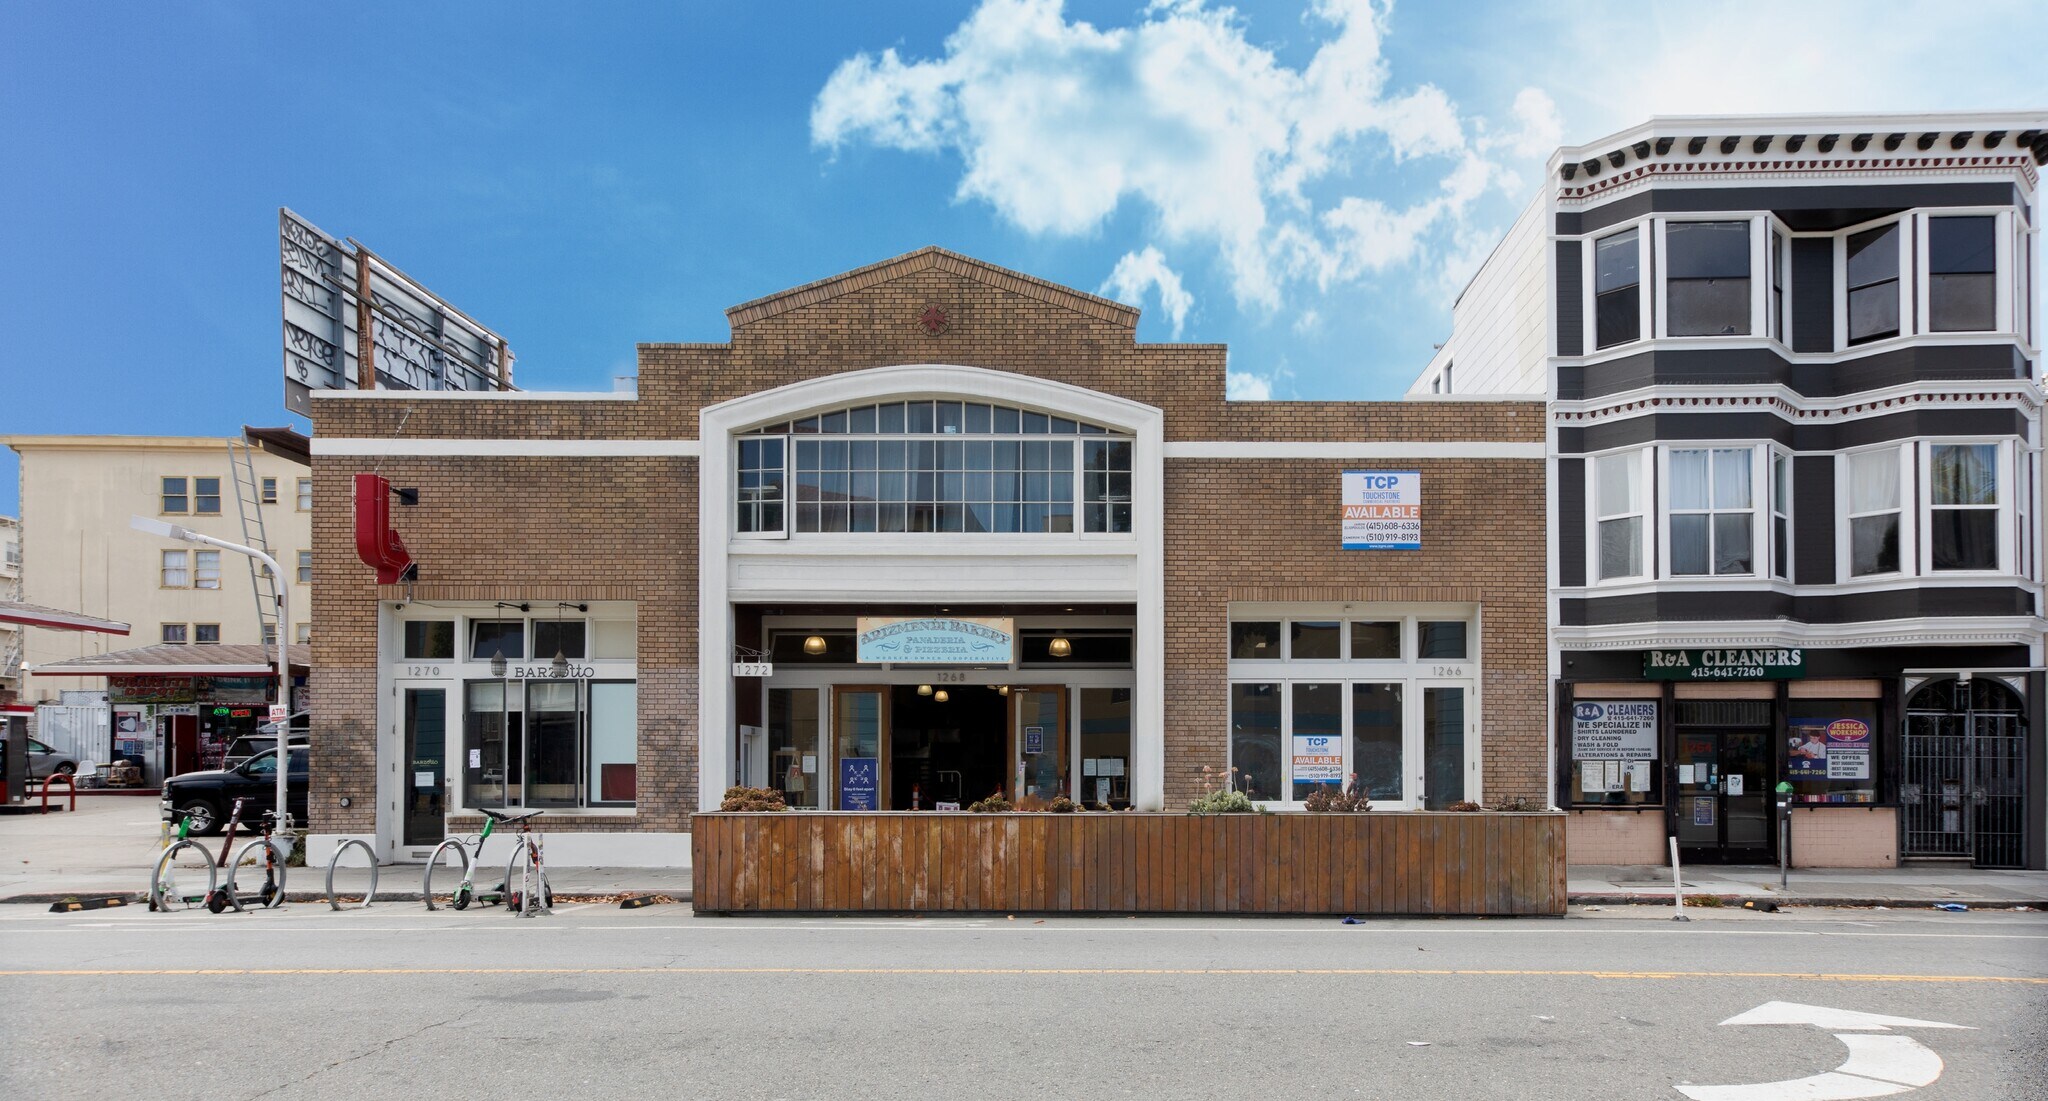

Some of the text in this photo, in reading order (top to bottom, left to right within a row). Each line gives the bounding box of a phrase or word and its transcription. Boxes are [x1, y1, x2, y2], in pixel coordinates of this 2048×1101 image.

[1363, 476, 1399, 489] TCP
[1362, 491, 1400, 500] TOUCHSTONE
[1344, 506, 1419, 519] AVAILABLE
[861, 621, 1010, 645] ARIZMENDI BAKERY
[906, 636, 966, 644] PANADERIA
[903, 645, 969, 654] & PIZZERIA
[1650, 650, 1691, 667] R&A
[1701, 650, 1802, 666] CLEANERS
[407, 666, 440, 676] 1270
[736, 665, 768, 676] 1272
[1433, 666, 1462, 676] 1266
[1691, 667, 1765, 677] 415-641-7260
[937, 672, 966, 682] 1268
[124, 687, 176, 697] DEPOT
[213, 708, 229, 716] ATM
[271, 708, 286, 717] ATM
[1576, 704, 1654, 717] R&A CLEANERS
[1307, 738, 1328, 746] TCP
